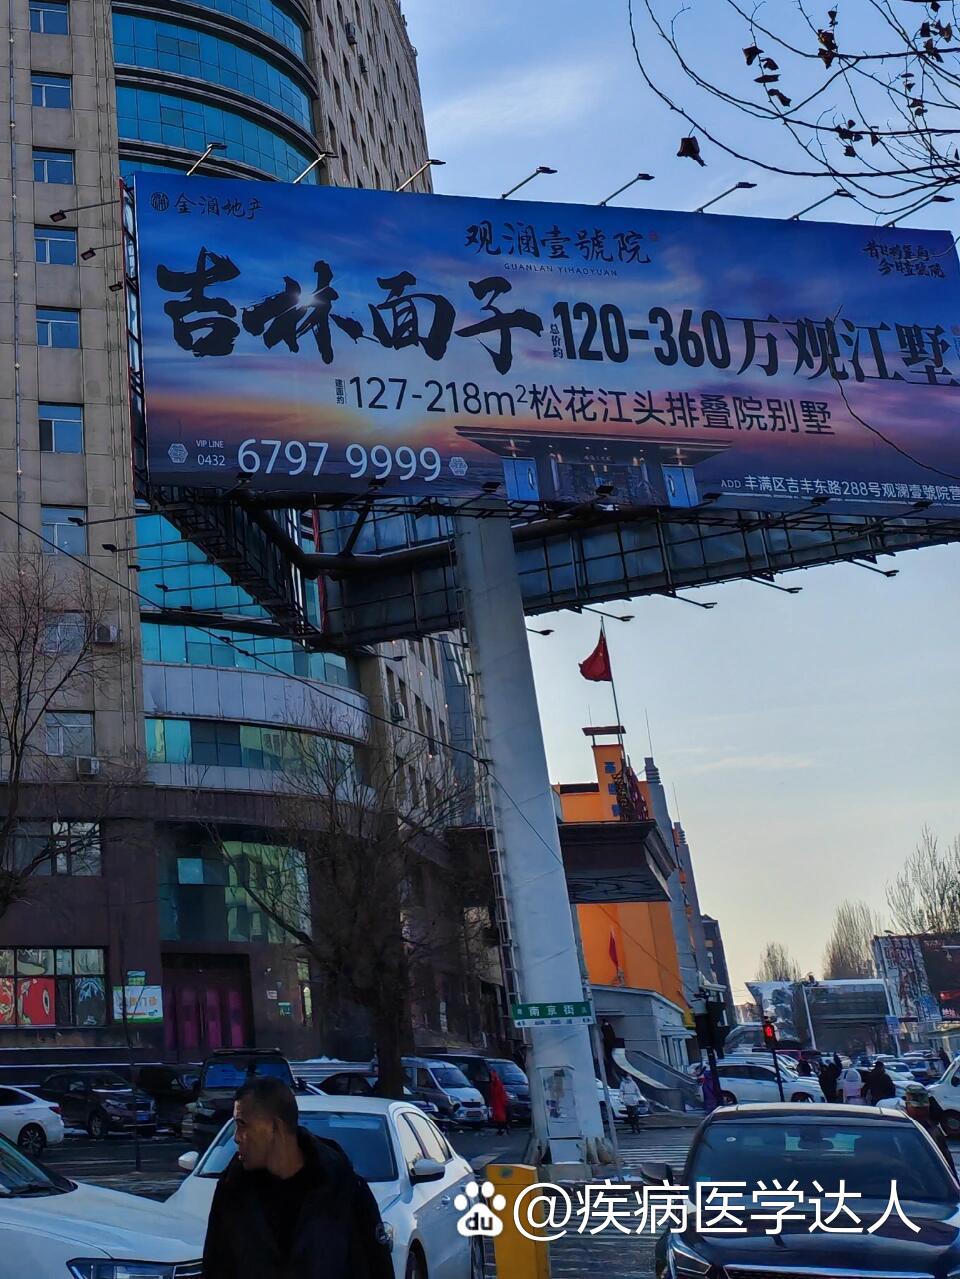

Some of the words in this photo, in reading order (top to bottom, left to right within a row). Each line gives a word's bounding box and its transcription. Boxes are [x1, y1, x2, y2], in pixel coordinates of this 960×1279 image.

[503, 262, 554, 272] GUANLAN
[557, 266, 618, 277] YIHAOYUAN
[156, 246, 544, 375] 吉林面子
[195, 439, 208, 448] VIP
[208, 440, 225, 449] LINE
[197, 454, 227, 467] 0432
[237, 438, 329, 476] 6797
[345, 443, 441, 483] 9999
[720, 479, 742, 489] ADD
[528, 1004, 575, 1017] 南京街
